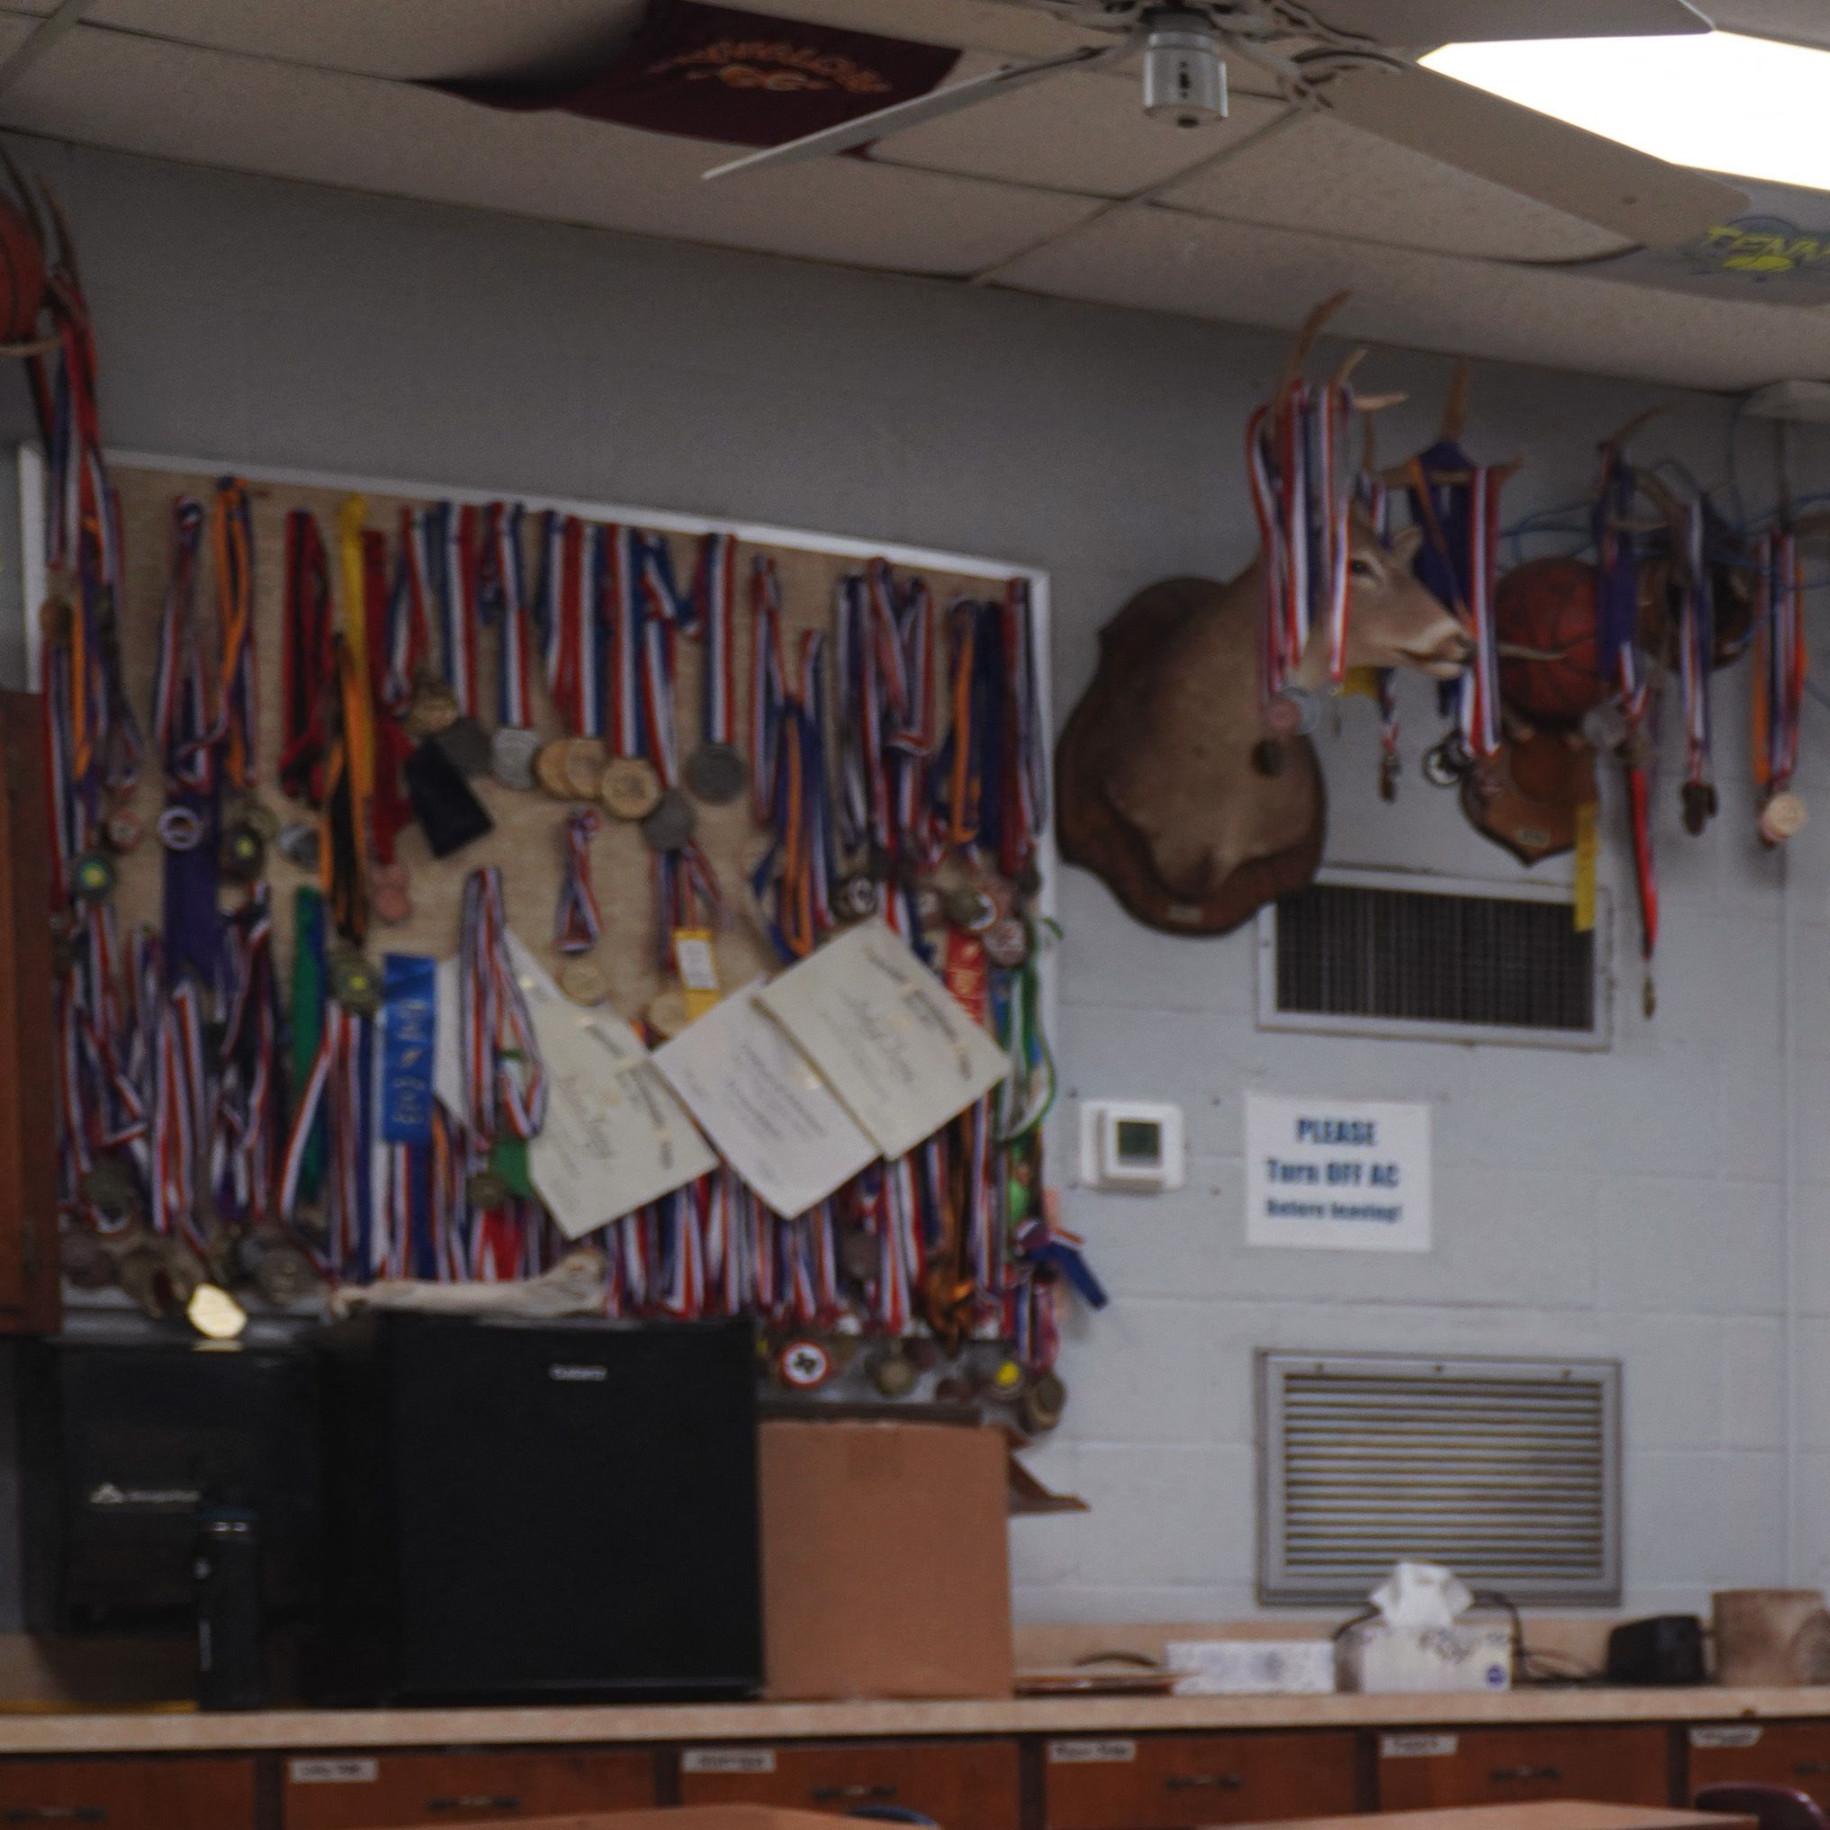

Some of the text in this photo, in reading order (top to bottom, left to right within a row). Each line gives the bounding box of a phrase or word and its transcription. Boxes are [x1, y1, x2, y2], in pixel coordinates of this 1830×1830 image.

[1295, 1116, 1377, 1146] PLEASE
[1264, 1154, 1399, 1187] Turn OFF AC
